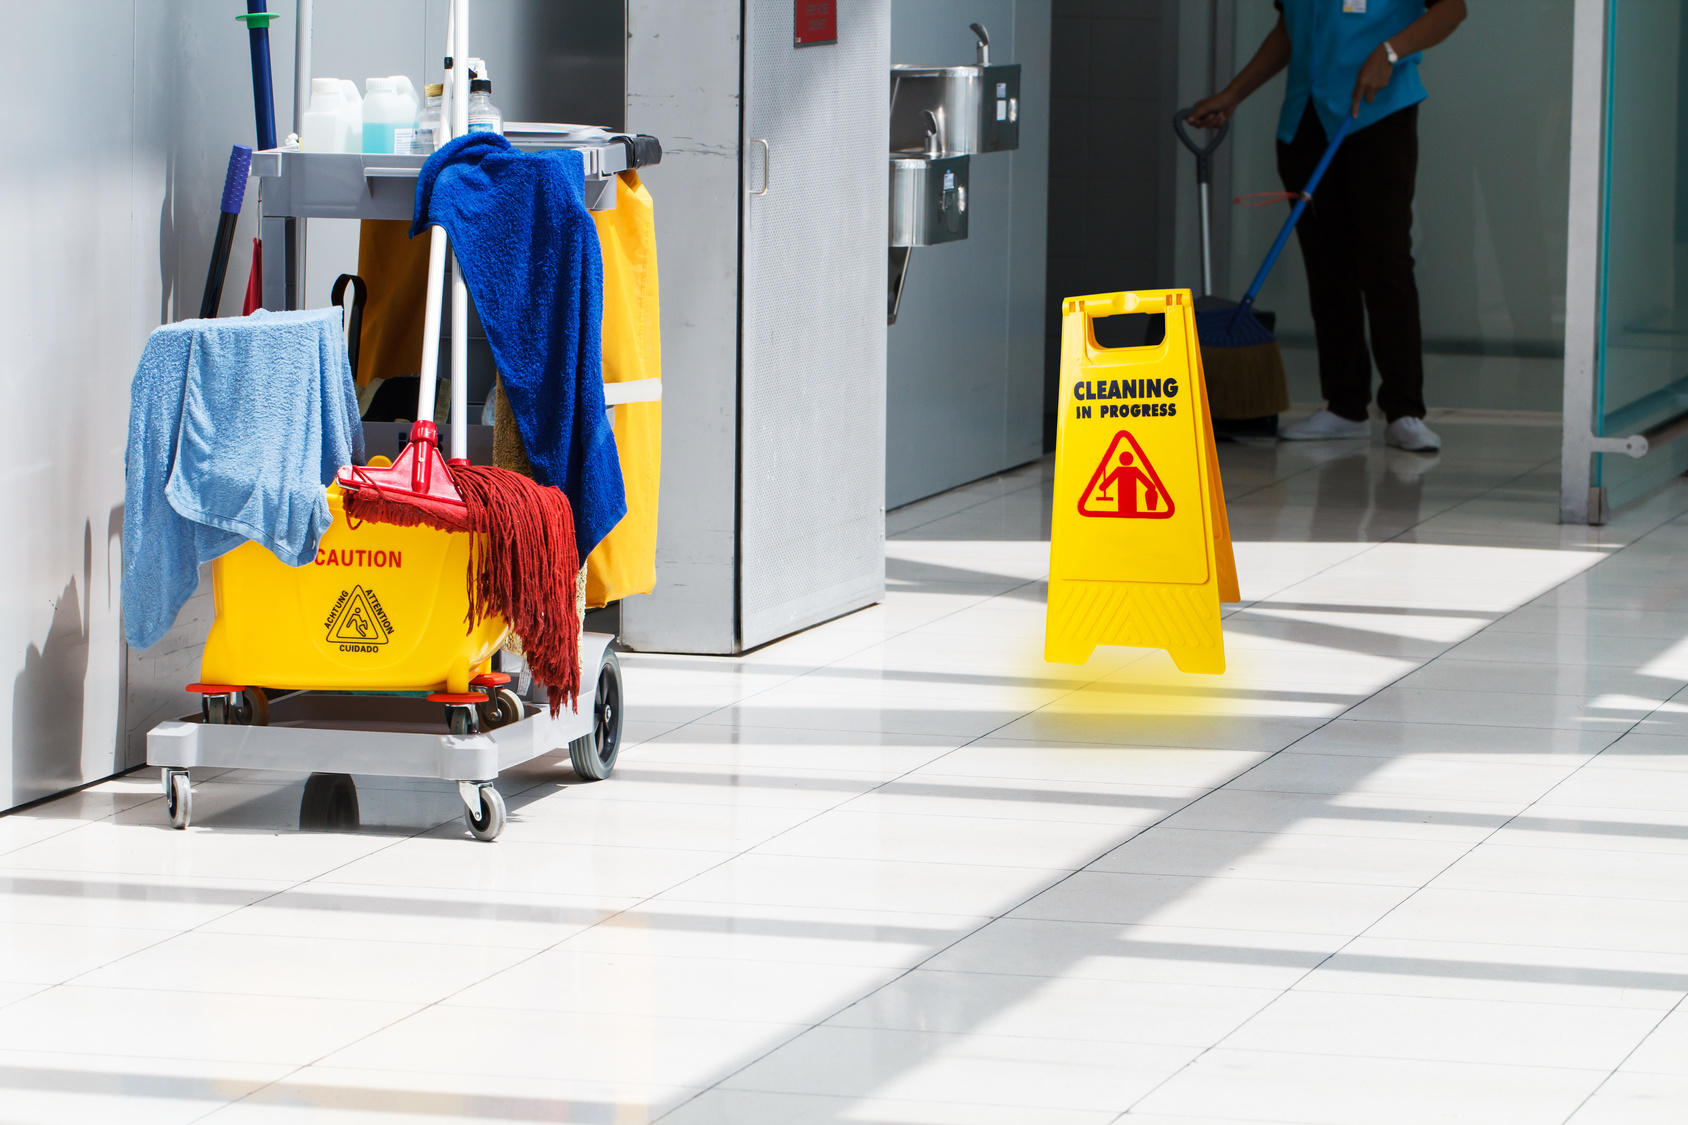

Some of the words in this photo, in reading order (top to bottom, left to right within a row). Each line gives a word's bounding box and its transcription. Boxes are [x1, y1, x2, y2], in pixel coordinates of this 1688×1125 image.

[1074, 378, 1178, 401] CLEANING
[1076, 406, 1092, 419] IN
[1101, 403, 1177, 418] PROGRESS
[315, 548, 402, 568] CAUTION
[324, 590, 349, 629] ACHTUNG
[365, 589, 395, 635] ATTENTION
[339, 644, 379, 653] CUIDADO
